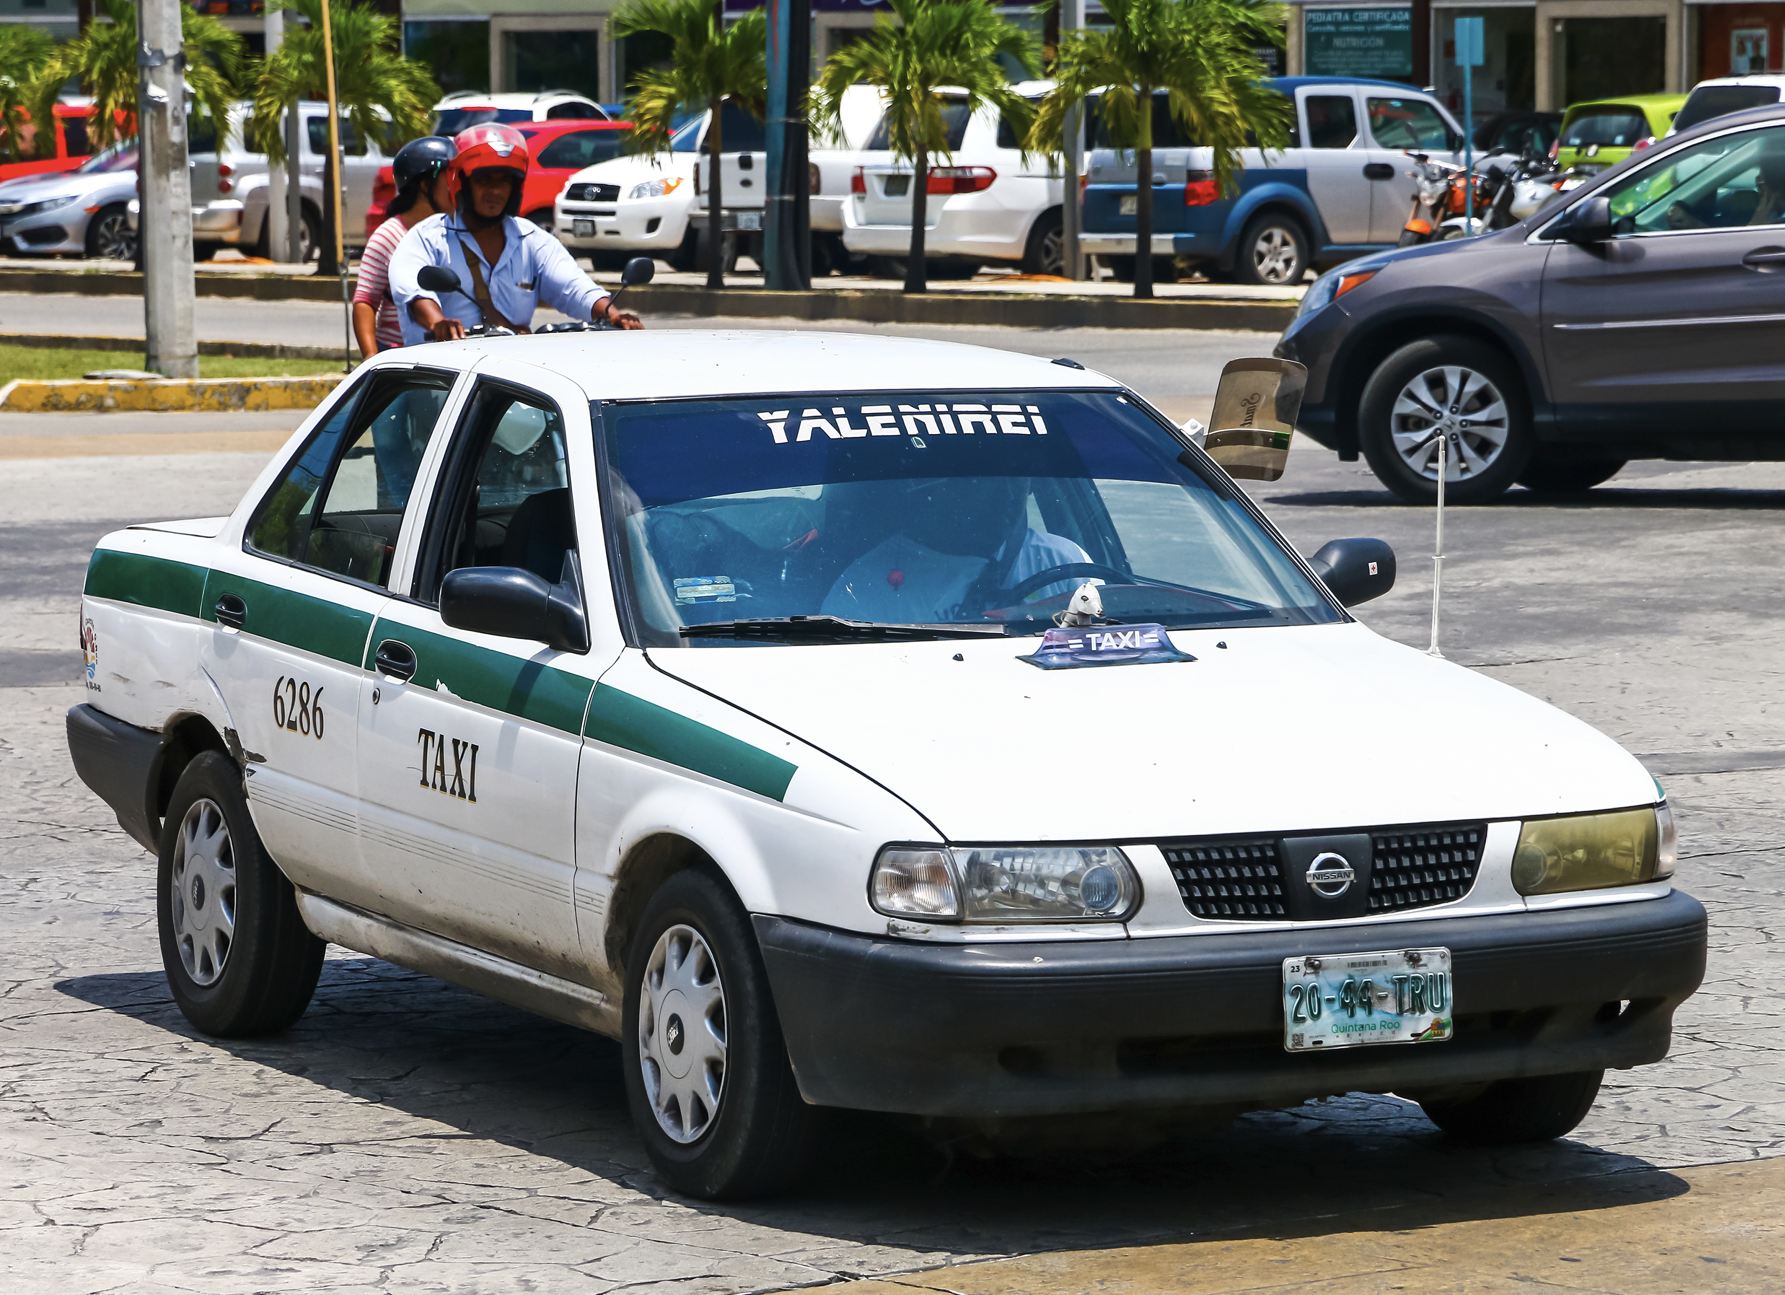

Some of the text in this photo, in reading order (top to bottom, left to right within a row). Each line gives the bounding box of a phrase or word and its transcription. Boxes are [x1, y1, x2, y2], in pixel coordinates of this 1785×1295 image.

[273, 675, 325, 741] 6286
[418, 727, 480, 803] TAXI
[1312, 871, 1351, 881] NISSAN
[1290, 965, 1301, 973] 23
[1331, 1020, 1401, 1034] Quintana Roo
